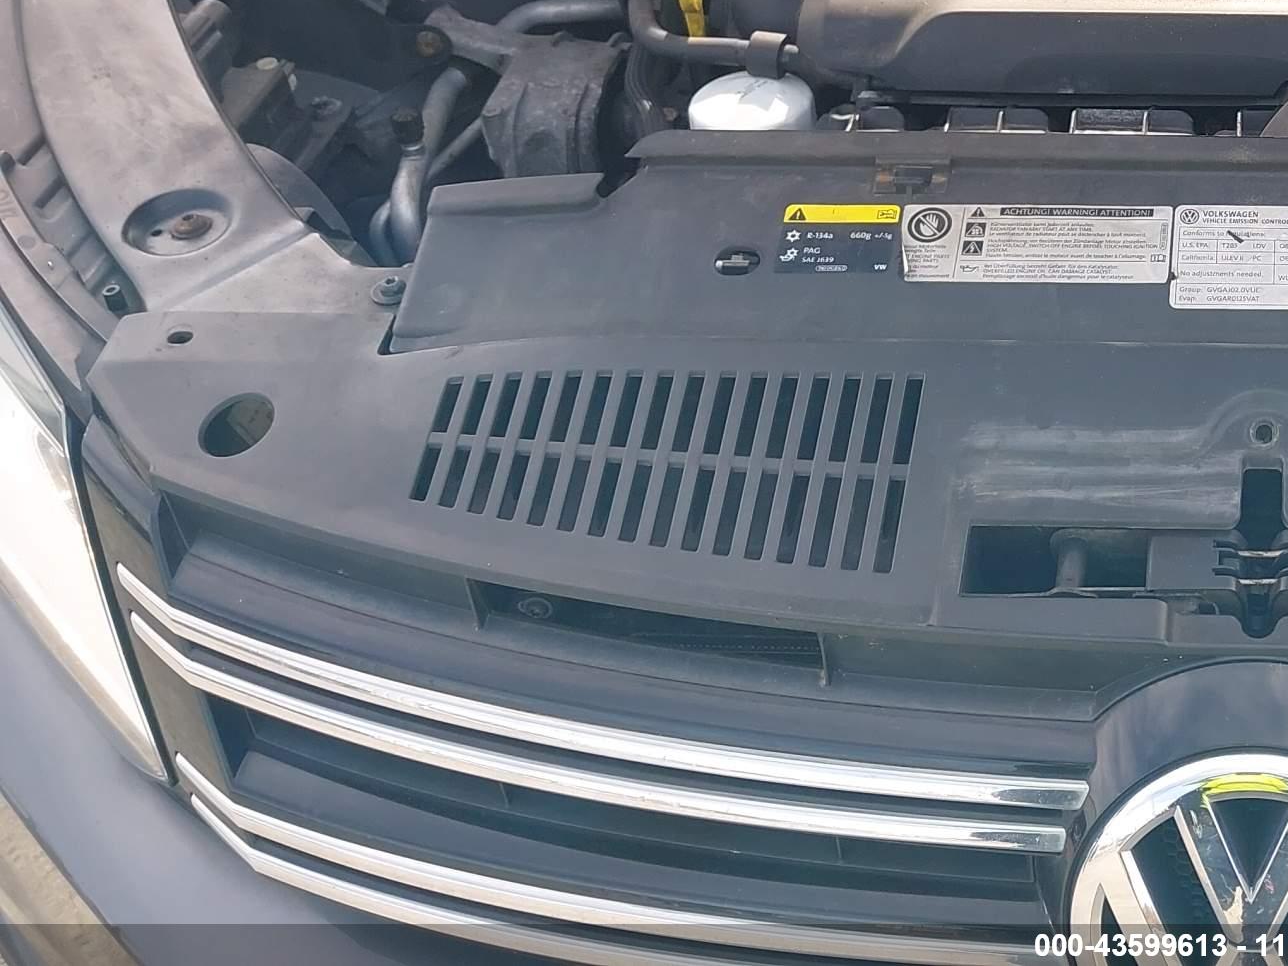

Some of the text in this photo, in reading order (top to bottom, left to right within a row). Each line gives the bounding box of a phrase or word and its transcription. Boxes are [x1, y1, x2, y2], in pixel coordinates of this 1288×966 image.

[1052, 208, 1098, 216] WARNING!
[1100, 209, 1151, 217] ATTENTION!
[1202, 210, 1259, 218] VOLKSWAGEN
[807, 232, 834, 240] R-134a
[803, 246, 821, 254] PAG
[1191, 270, 1235, 278] adjustments
